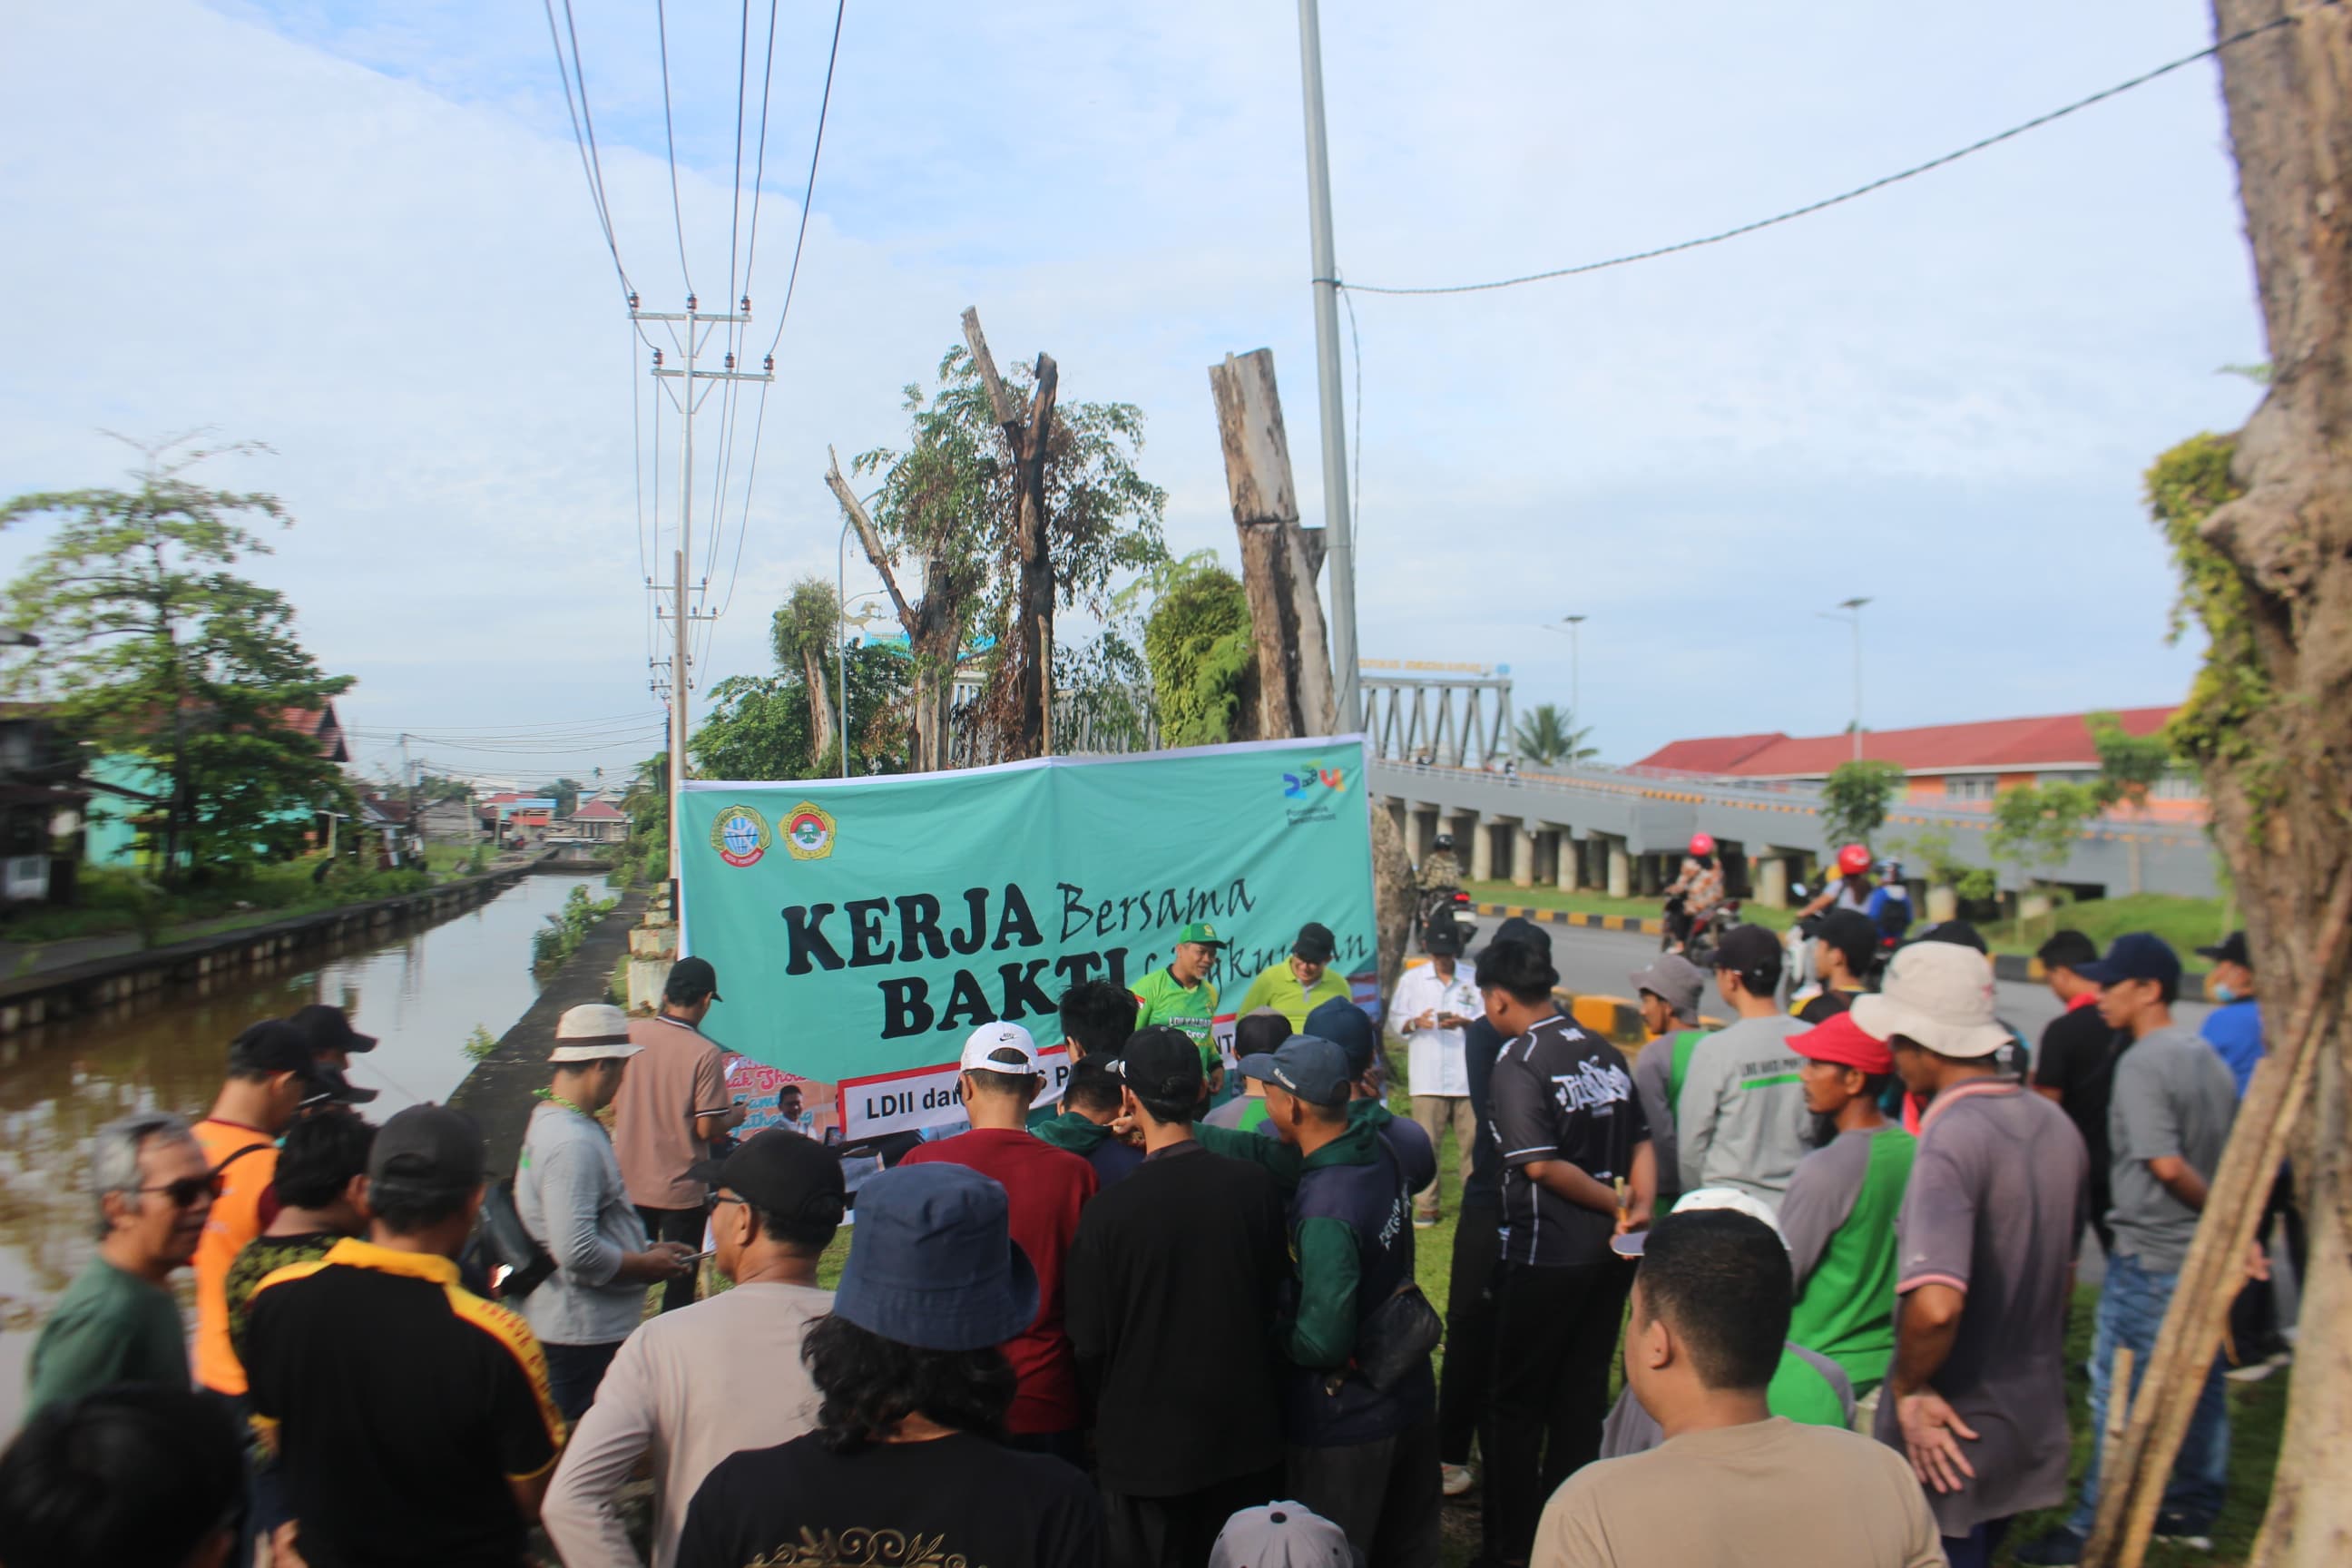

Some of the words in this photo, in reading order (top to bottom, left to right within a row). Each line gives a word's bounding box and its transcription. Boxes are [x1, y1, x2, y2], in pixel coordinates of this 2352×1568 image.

[781, 883, 1043, 975] KERJA
[1056, 877, 1257, 944] Bersama
[877, 946, 1129, 1040] BAKTI
[867, 1091, 914, 1120] LDII
